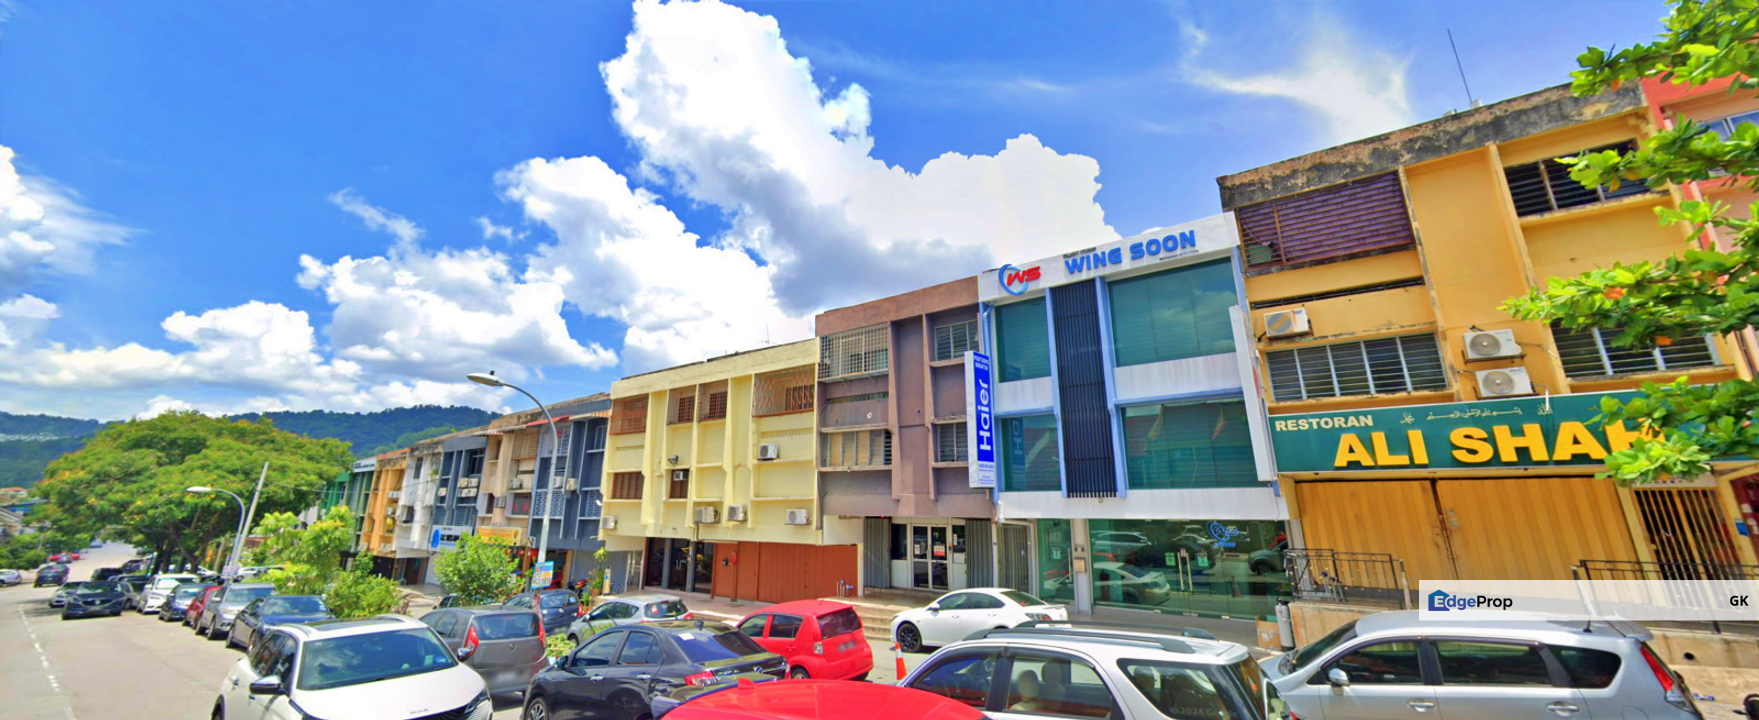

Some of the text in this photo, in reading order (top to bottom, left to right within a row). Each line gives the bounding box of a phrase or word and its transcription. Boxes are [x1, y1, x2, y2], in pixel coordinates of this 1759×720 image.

[1064, 247, 1122, 274] WING
[1129, 229, 1196, 260] SOON
[1006, 266, 1041, 286] WS
[977, 379, 991, 451] Haier
[1275, 414, 1373, 432] RESTORAN
[1334, 430, 1429, 467] ALI
